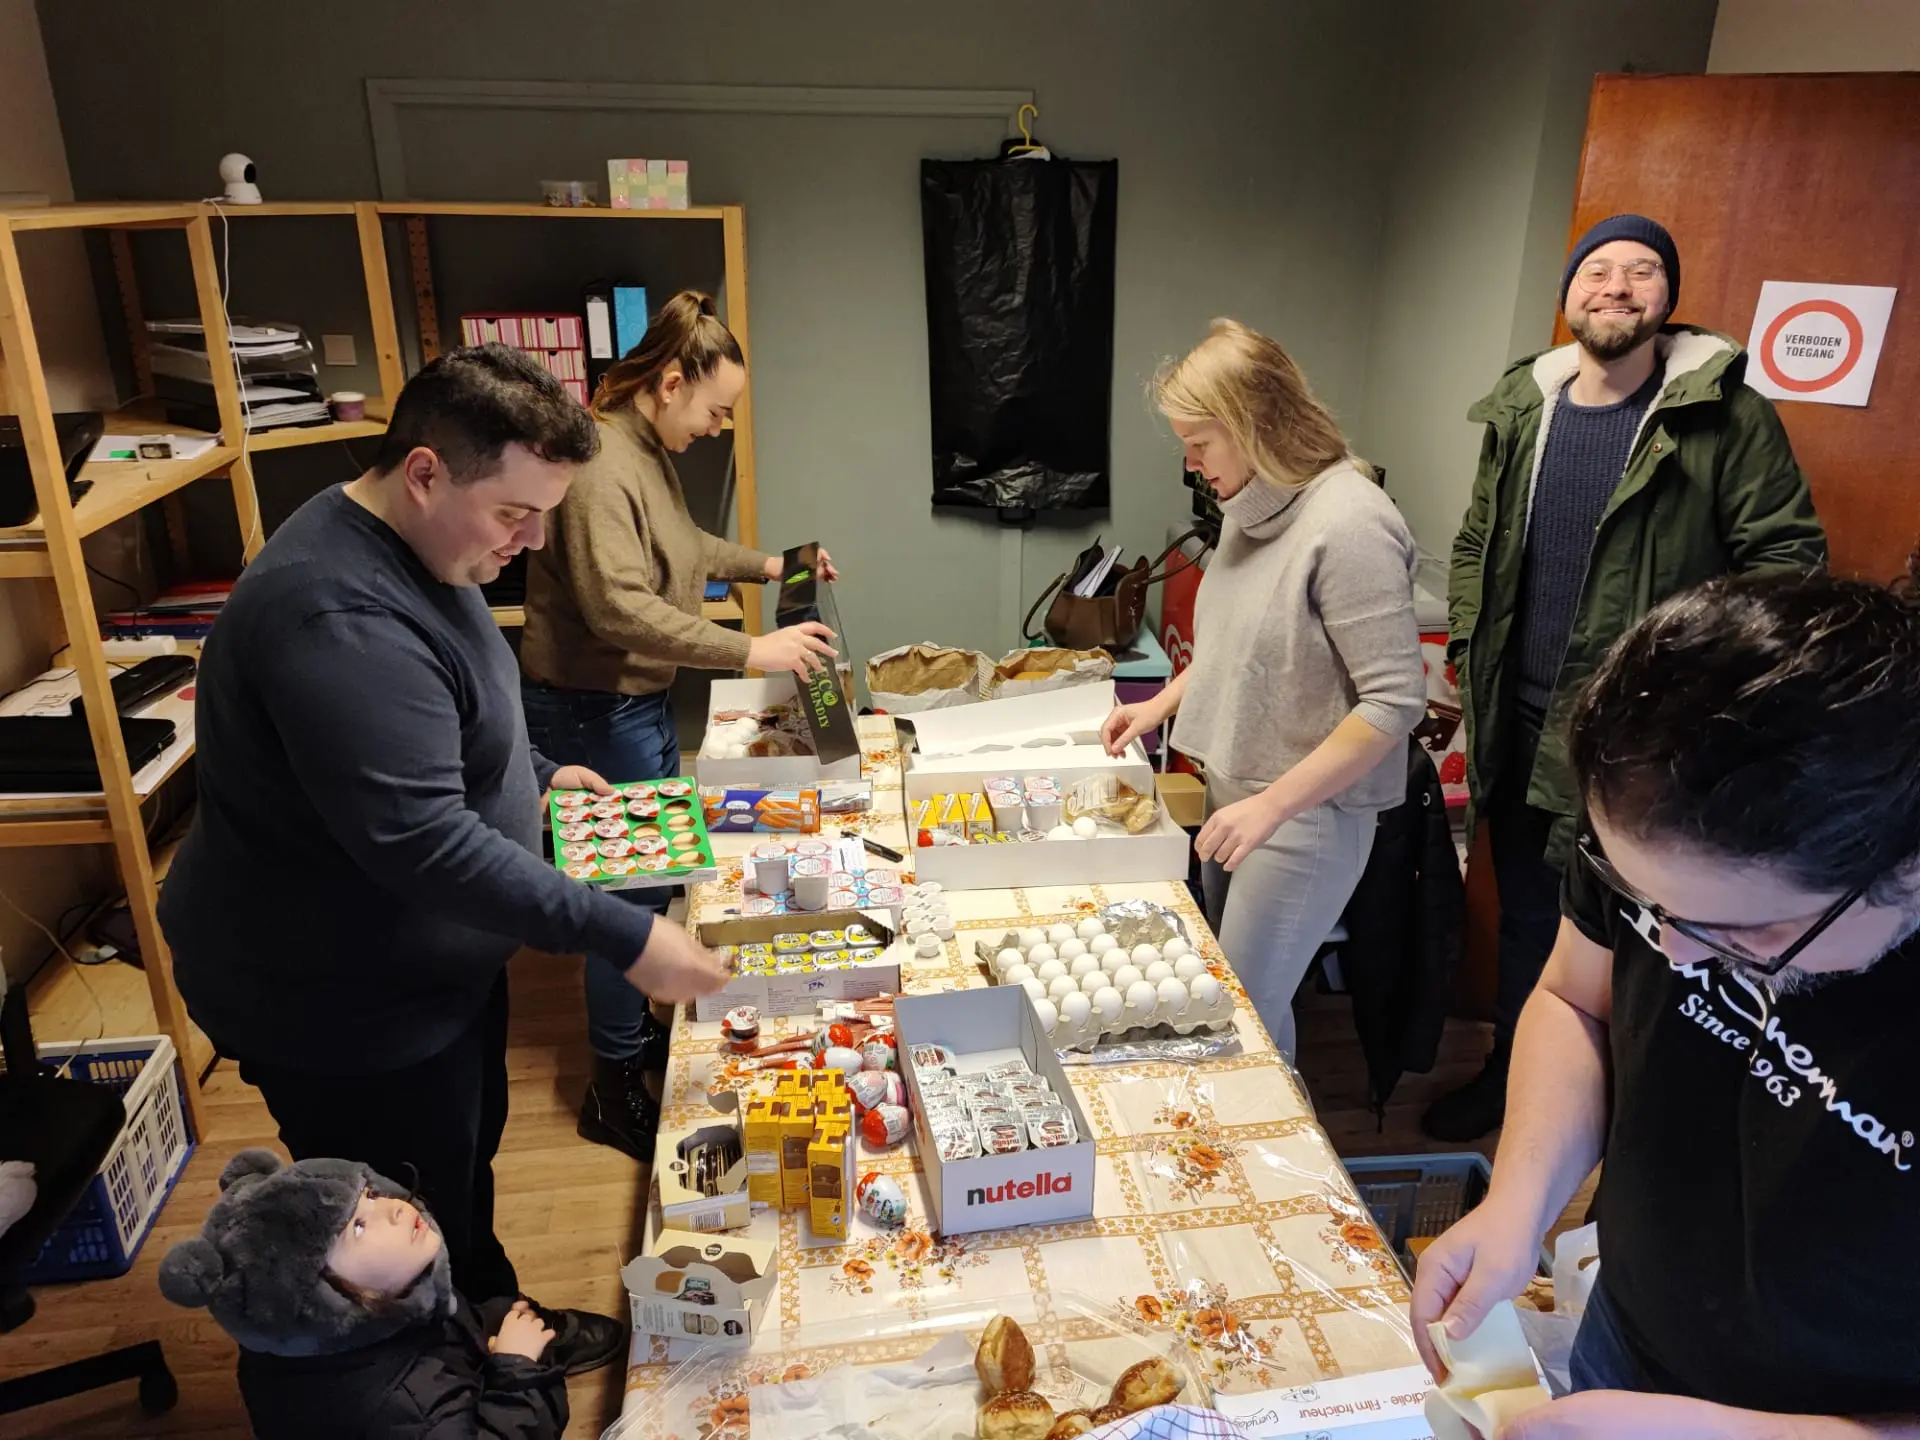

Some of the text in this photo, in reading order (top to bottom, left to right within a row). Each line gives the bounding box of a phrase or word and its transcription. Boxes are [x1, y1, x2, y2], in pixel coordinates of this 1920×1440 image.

[1785, 334, 1842, 347] VERBODEN
[1786, 347, 1835, 359] TOEGANG
[1678, 993, 1750, 1051] Since
[967, 1172, 1072, 1206] nutella
[1356, 1400, 1382, 1411] Film
